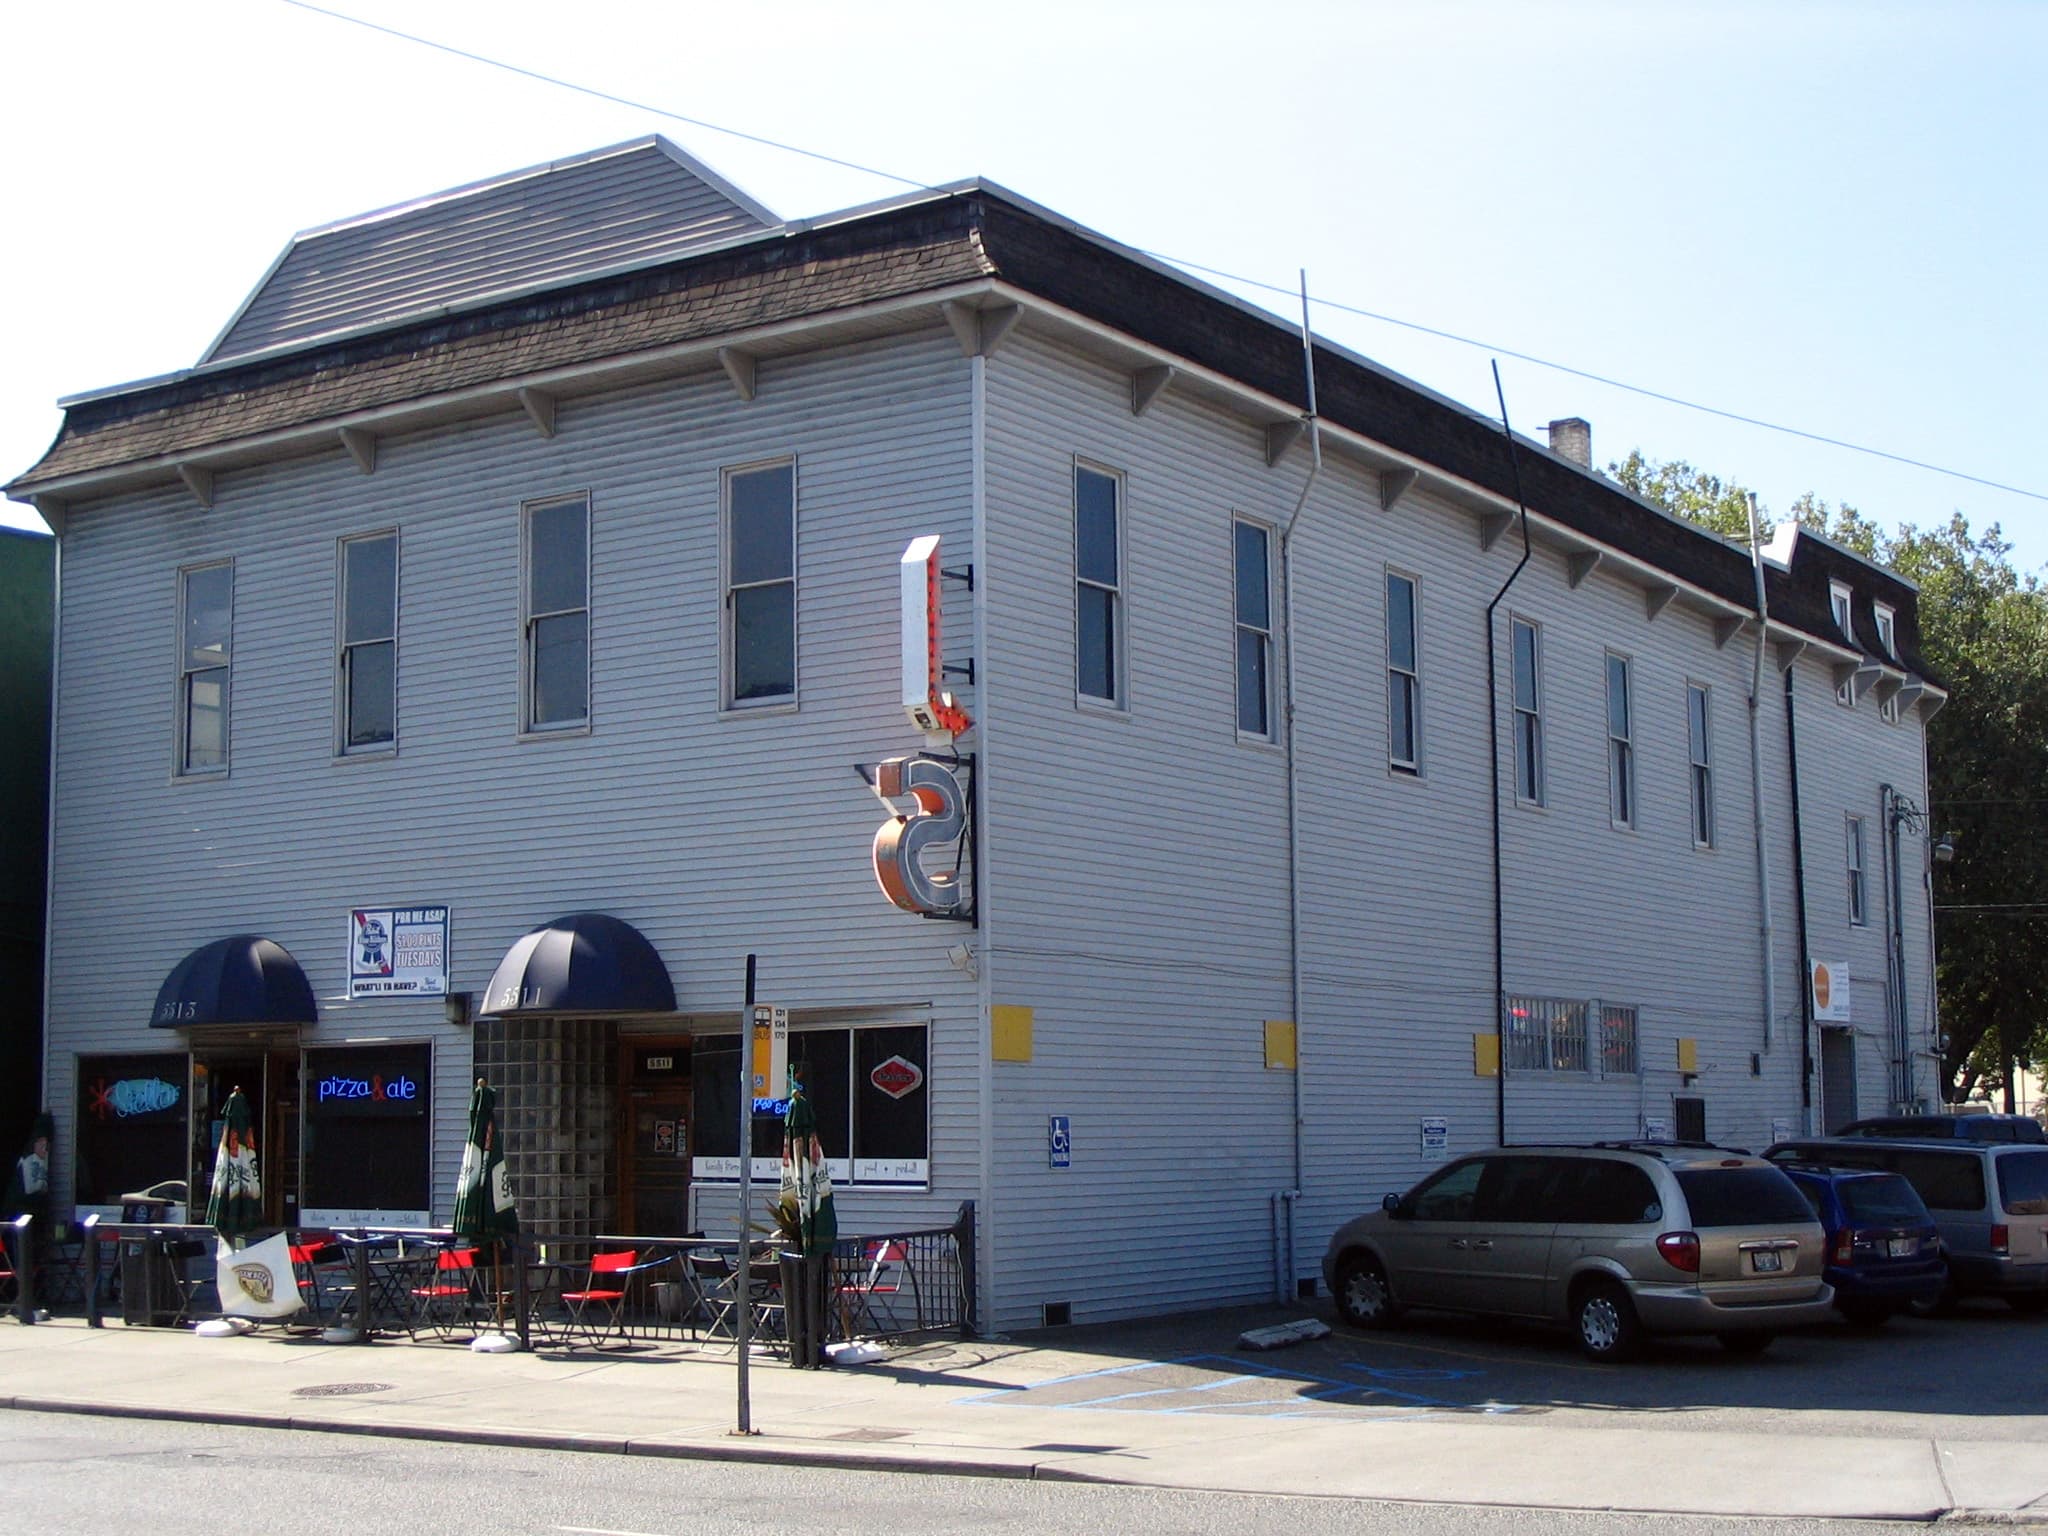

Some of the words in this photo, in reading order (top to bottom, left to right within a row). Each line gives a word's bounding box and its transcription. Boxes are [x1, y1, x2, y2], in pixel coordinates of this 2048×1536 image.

[412, 911, 424, 923] ME
[424, 909, 445, 923] ASAP
[396, 950, 441, 968] TUESDAYS
[394, 981, 417, 991] HAVE?
[501, 986, 541, 1007] 5511
[754, 1030, 770, 1040] BUS
[320, 1076, 373, 1103] pizza
[386, 1075, 416, 1099] ale
